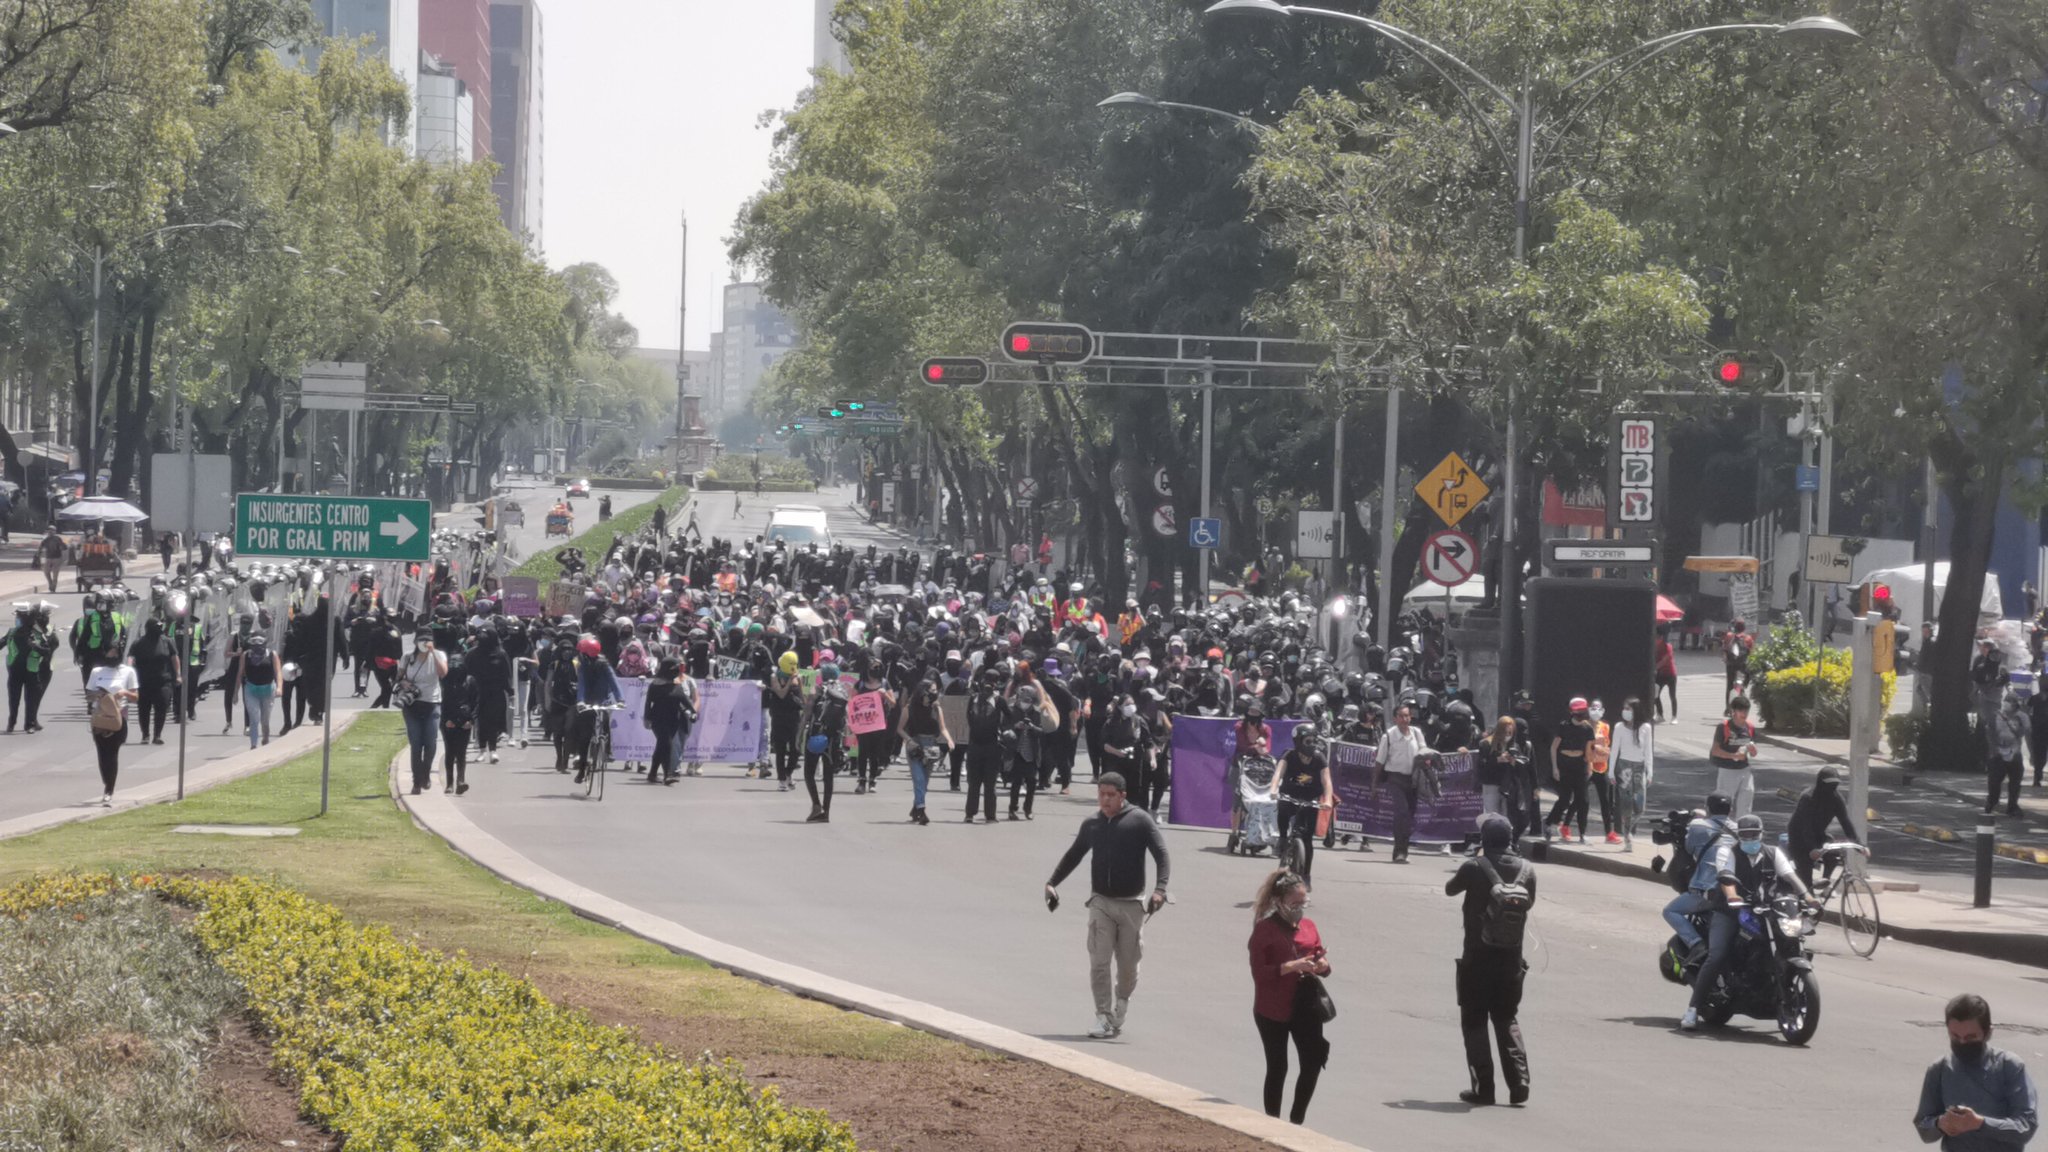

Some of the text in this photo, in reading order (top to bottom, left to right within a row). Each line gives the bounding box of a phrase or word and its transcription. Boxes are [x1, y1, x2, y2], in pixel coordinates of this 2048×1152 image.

[1626, 425, 1649, 448] MB
[249, 501, 370, 526] INSURGENTES CENTRO
[247, 527, 370, 552] POR GRAL PRIM
[1580, 550, 1626, 558] REFORMA
